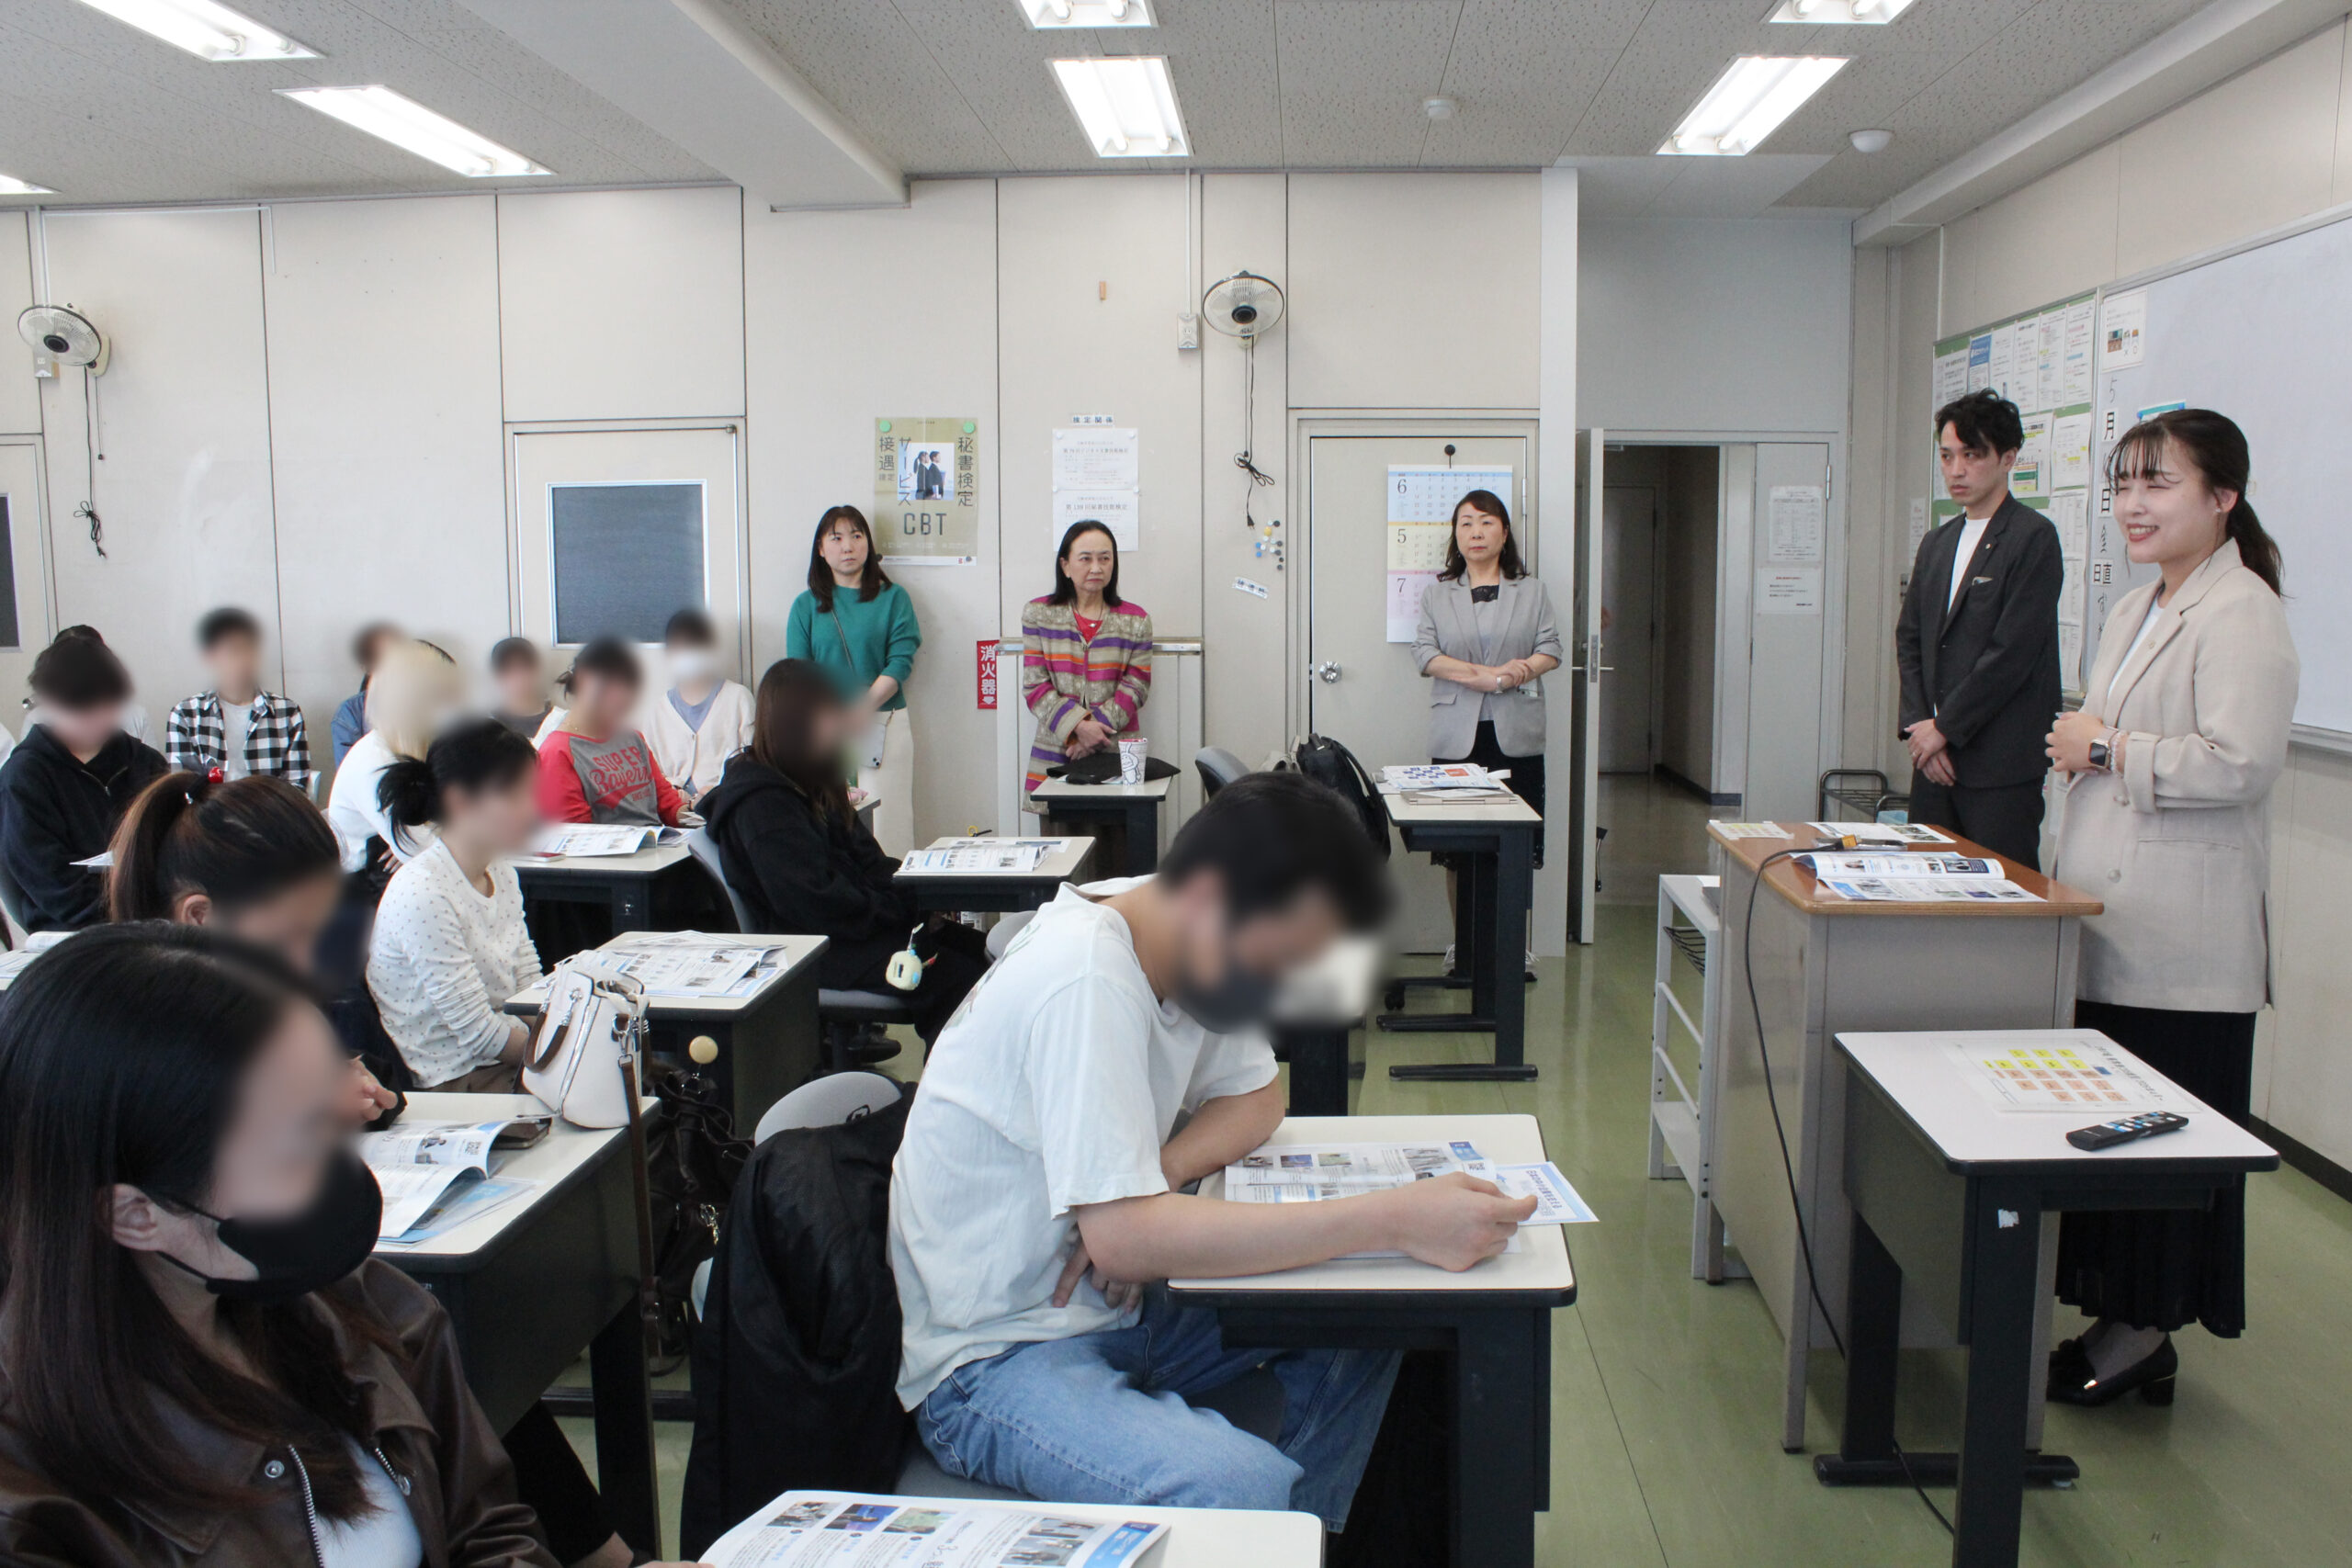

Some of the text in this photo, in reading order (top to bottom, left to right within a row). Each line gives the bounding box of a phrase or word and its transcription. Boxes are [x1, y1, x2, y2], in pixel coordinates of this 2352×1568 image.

[2104, 412, 2115, 440] 月
[879, 435, 895, 470] 接遇
[898, 436, 912, 506] サービス
[957, 435, 974, 506] 秘書検定
[1397, 479, 1408, 494] 6
[2101, 488, 2111, 513] 日
[904, 513, 947, 536] CBT
[1397, 528, 1407, 544] 5
[1396, 578, 1407, 593] 7
[2094, 562, 2112, 584] 日直
[980, 645, 997, 695] 消火器
[593, 746, 642, 772] SUPER
